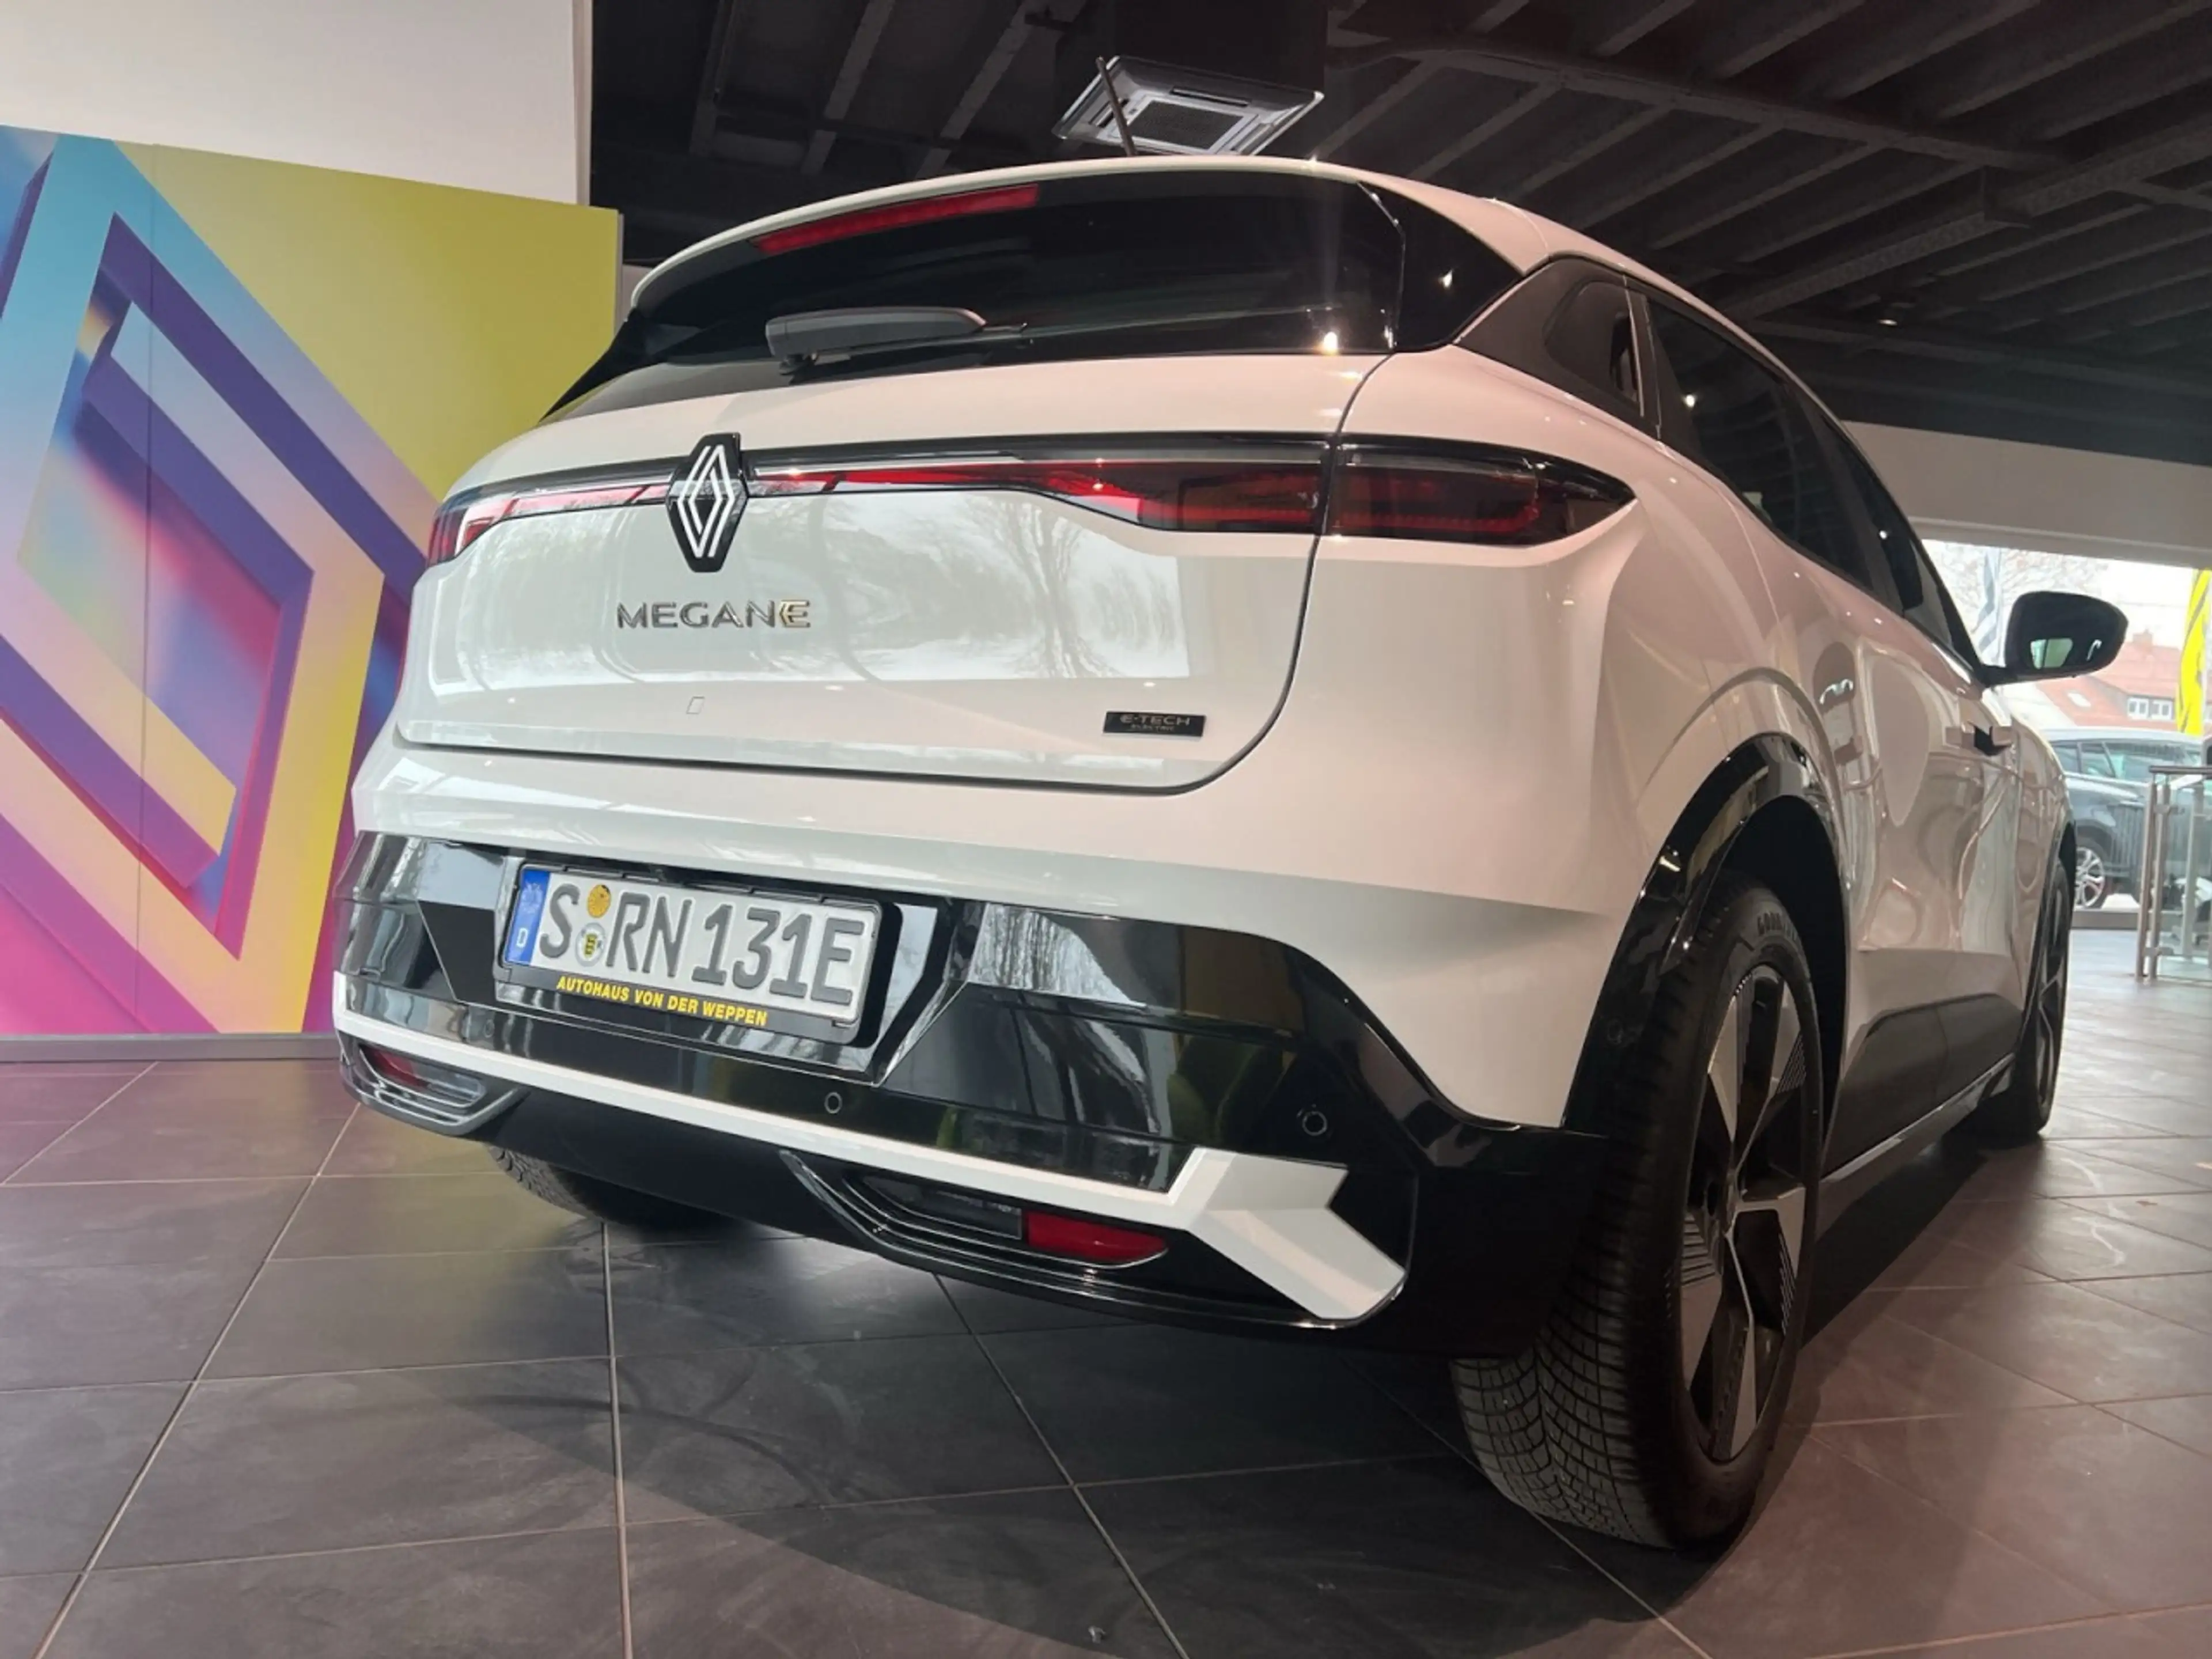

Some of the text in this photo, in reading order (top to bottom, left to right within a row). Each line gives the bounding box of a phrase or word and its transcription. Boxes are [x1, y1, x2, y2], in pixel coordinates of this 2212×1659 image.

[616, 600, 811, 629] MEGANE
[1119, 713, 1191, 726] E-TECH
[539, 882, 579, 959] S
[516, 928, 528, 948] D
[556, 976, 768, 1027] AUTOHAUS VON DER WEPPEN
